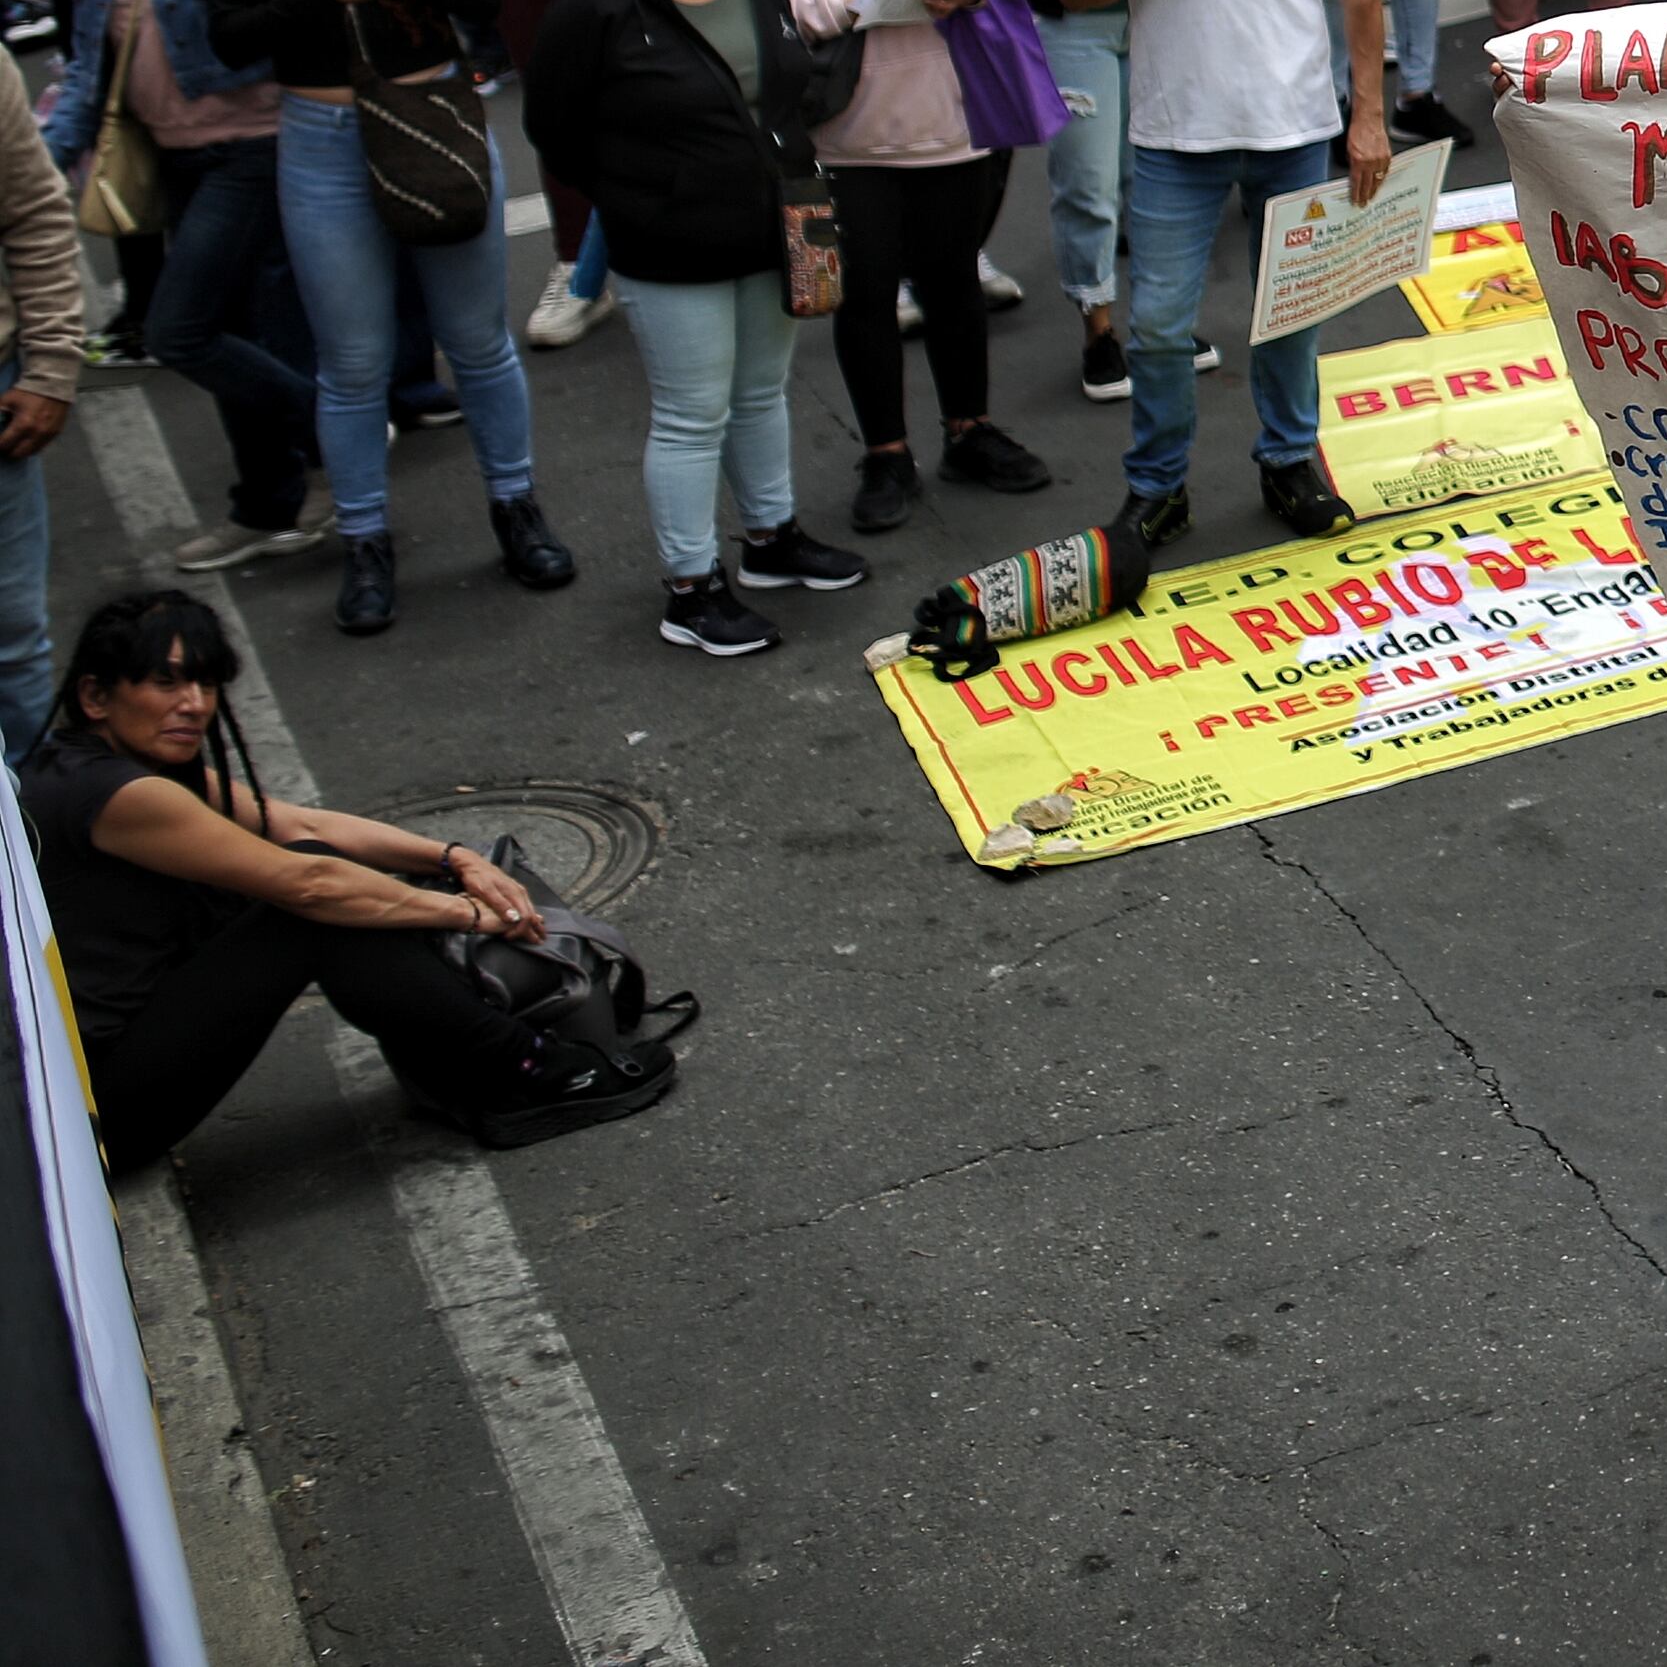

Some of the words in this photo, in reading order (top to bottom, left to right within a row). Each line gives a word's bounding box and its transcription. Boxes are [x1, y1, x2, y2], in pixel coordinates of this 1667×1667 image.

[1335, 356, 1558, 421] BERN
[951, 623, 1234, 726] LUCILA
[1231, 561, 1464, 652] RUBIO
[1464, 537, 1558, 591] DE
[1242, 620, 1460, 694] Localidad
[1468, 608, 1518, 632] 10
[1289, 687, 1501, 754] Asociación
[1510, 646, 1660, 694] Distrital
[1350, 746, 1374, 765] y
[1381, 674, 1638, 751] Trabajadoras
[1060, 792, 1233, 842] ucación
